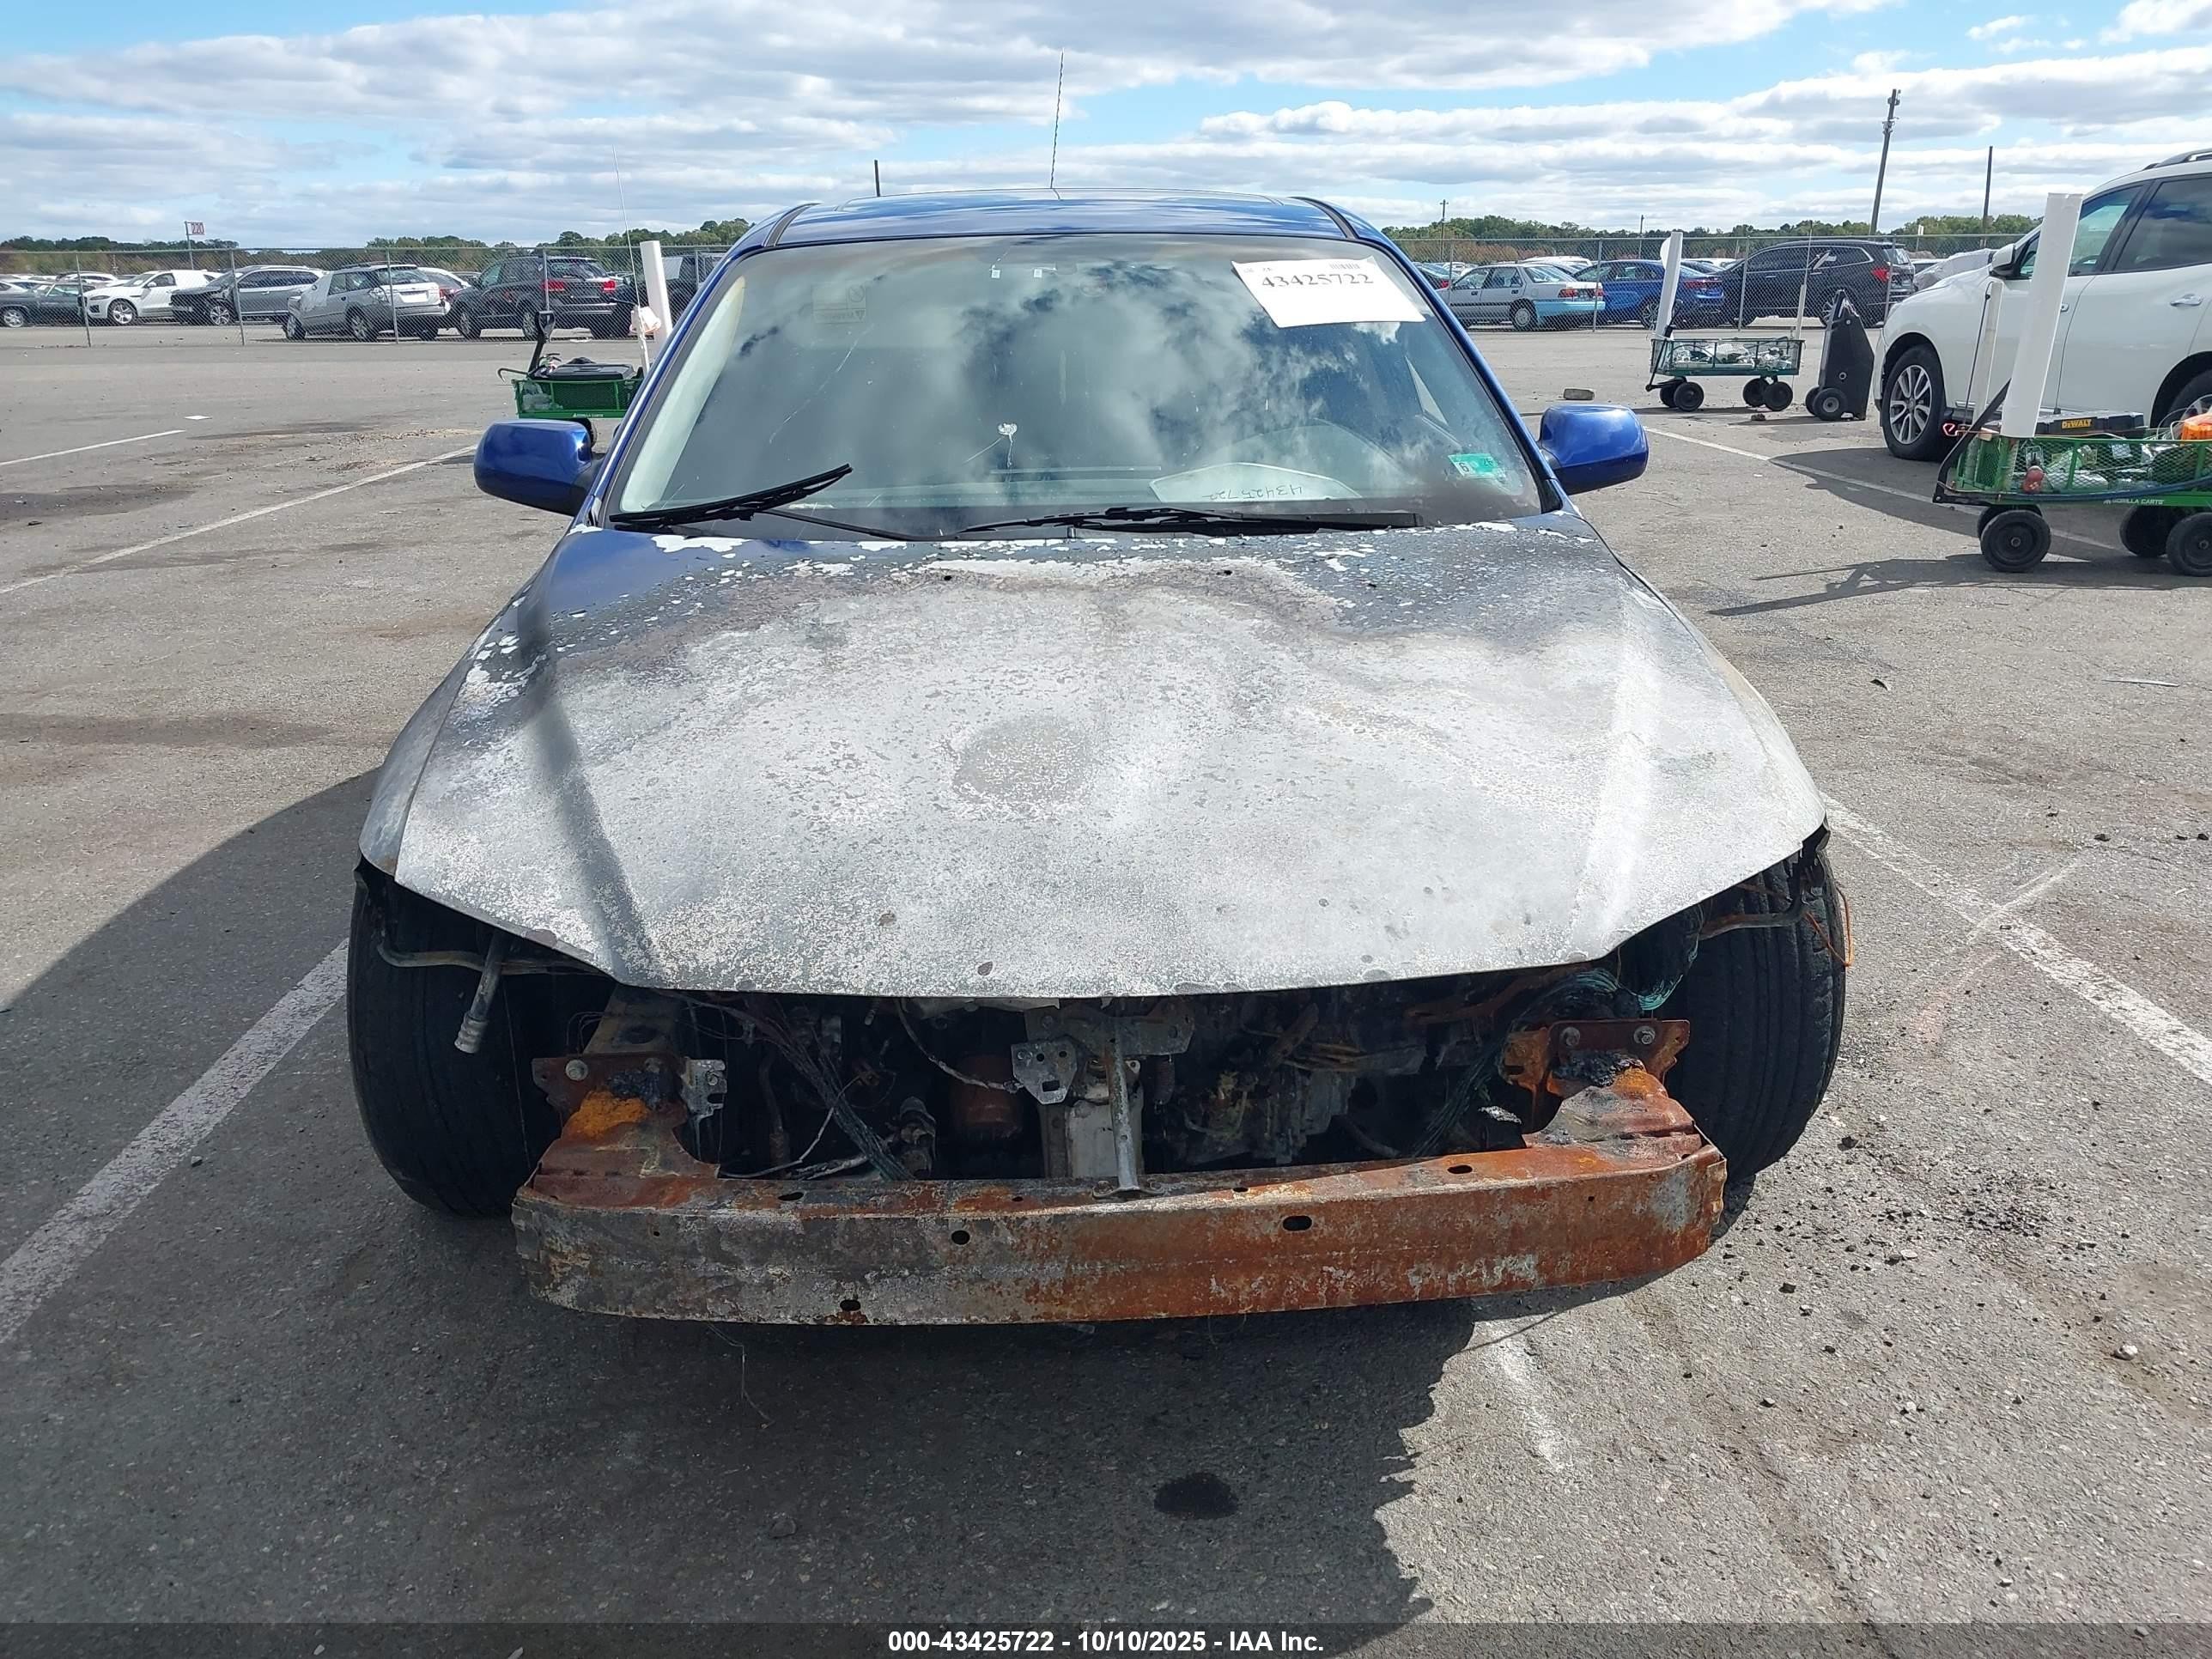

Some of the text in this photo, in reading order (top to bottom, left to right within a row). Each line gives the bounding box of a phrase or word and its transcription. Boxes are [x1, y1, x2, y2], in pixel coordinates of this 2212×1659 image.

[191, 222, 204, 234] 220
[1261, 274, 1374, 288] 43425722
[1201, 484, 1302, 500] 43425722
